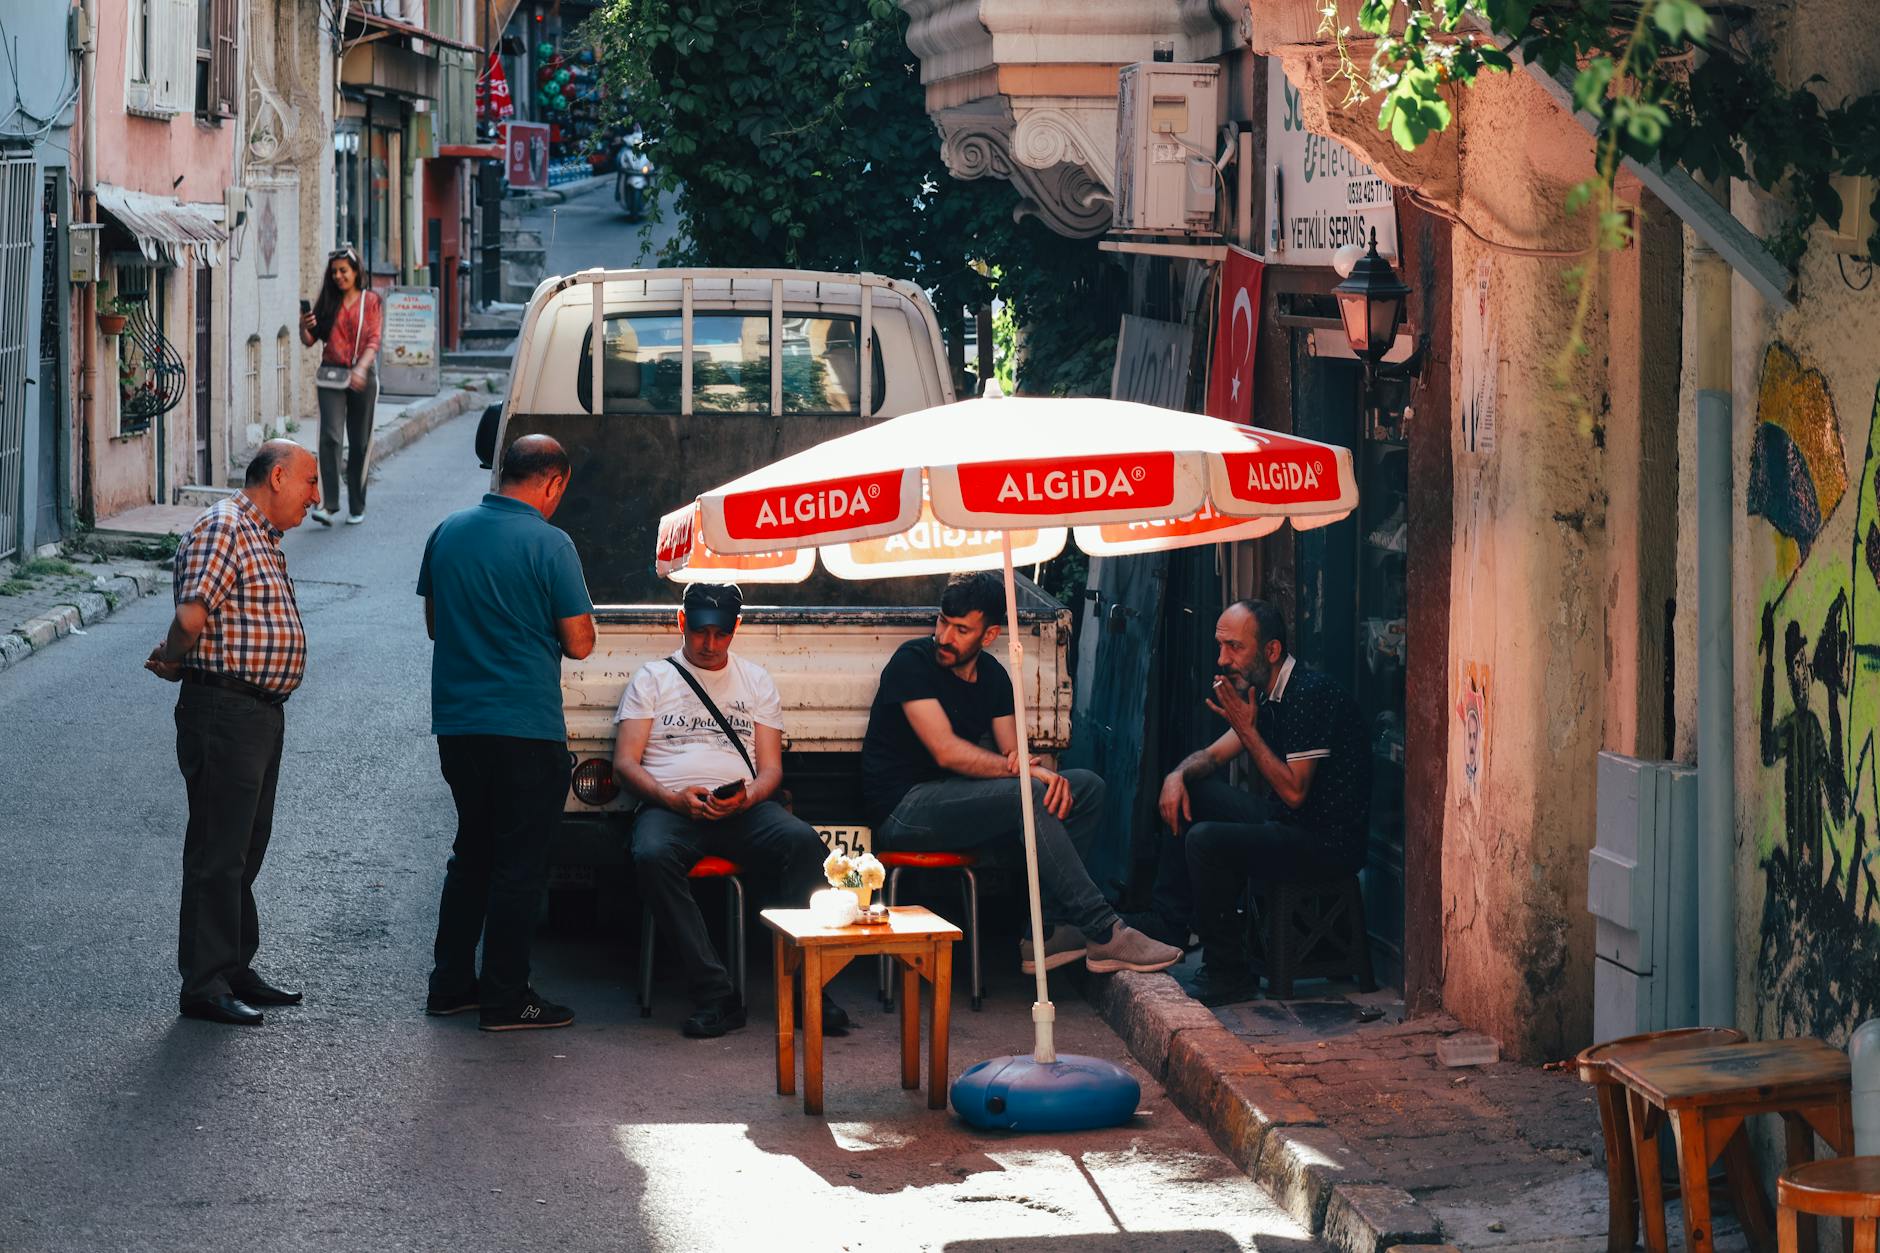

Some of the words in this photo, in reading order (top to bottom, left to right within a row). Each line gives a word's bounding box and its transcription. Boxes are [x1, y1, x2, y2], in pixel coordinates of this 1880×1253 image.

[1364, 180, 1375, 203] 425
[1376, 180, 1383, 202] 77
[1291, 209, 1326, 249] YETKİLİ
[1329, 209, 1366, 249] SERVİS
